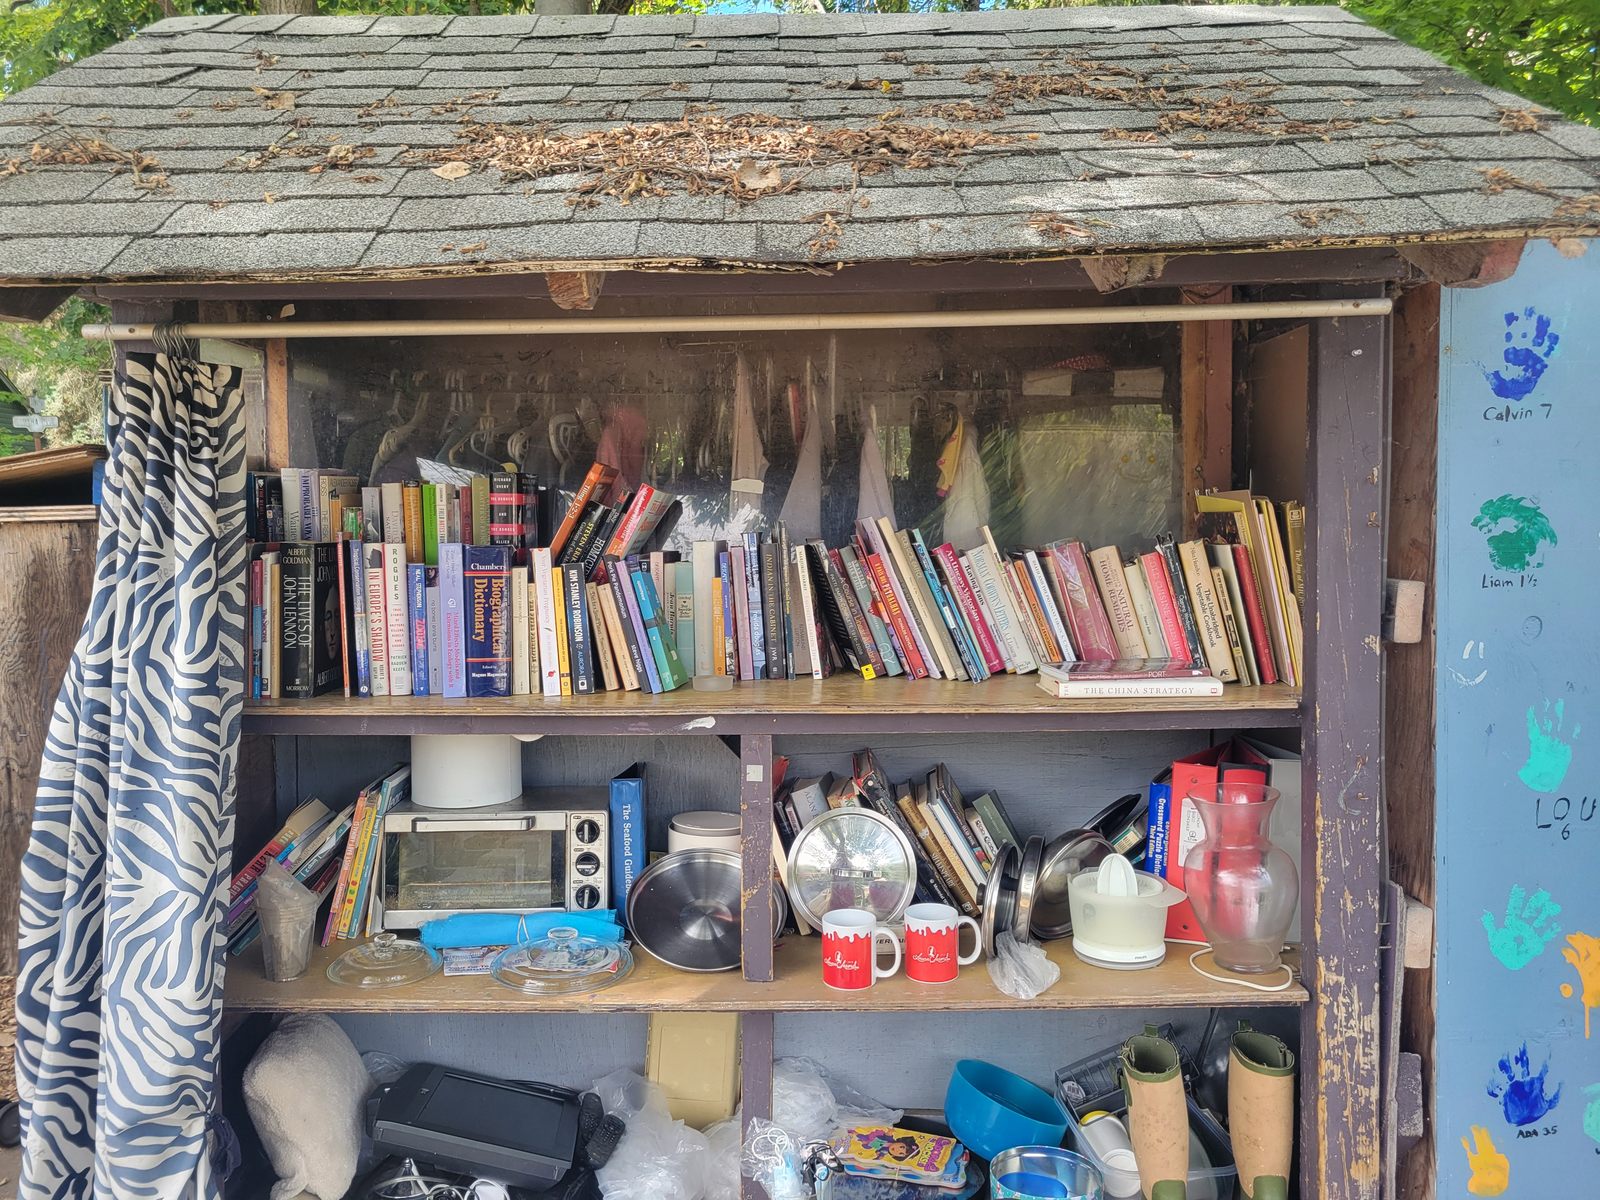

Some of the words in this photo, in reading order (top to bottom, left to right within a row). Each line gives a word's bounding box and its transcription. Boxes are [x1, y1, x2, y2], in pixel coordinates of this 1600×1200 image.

[1483, 404, 1533, 422] Calvin
[1540, 403, 1552, 419] 7
[583, 522, 594, 543] STEVEN
[282, 556, 312, 564] GOLDMAN
[287, 548, 306, 556] ALBERT
[573, 546, 583, 562] ERIK
[945, 548, 956, 562] An
[369, 571, 379, 580] IN
[470, 562, 506, 571] Chambers
[607, 561, 615, 573] Pork
[610, 573, 618, 582] Pie
[766, 554, 774, 582] INDIAN
[950, 562, 967, 589] Uneasy
[963, 565, 978, 589] Raving
[284, 575, 296, 603] JOHN
[298, 576, 311, 595] THE
[839, 576, 847, 584] A
[1482, 574, 1513, 589] Liam
[369, 584, 382, 624] EUROPE'S
[572, 582, 580, 610] STANLEY
[614, 583, 627, 618] Pandemonium
[828, 573, 838, 587] PATTI
[834, 587, 844, 603] SMITH
[840, 603, 854, 628] COMPLETE
[842, 584, 855, 607] Course
[962, 588, 981, 622] Victorian
[1100, 560, 1113, 587] HOME
[1108, 589, 1126, 633] REMEDIES
[1155, 581, 1171, 617] CUISINE
[1203, 589, 1213, 602] The
[298, 601, 311, 631] LIVES
[472, 579, 488, 642] Dictionary
[489, 579, 505, 654] Biographical
[850, 607, 859, 615] in
[1117, 589, 1134, 630] NATURAL
[1194, 583, 1208, 614] Vegetable
[1203, 615, 1216, 647] Cookbook
[1206, 602, 1222, 639] Unabridged
[284, 607, 296, 648] LENNON
[575, 610, 584, 643] ROBINSON
[769, 609, 777, 641] CABINET
[854, 615, 867, 635] Linear
[1182, 612, 1193, 631] Windows
[299, 634, 311, 648] OF
[371, 628, 383, 662] SHADOW
[630, 644, 639, 659] steve
[862, 635, 878, 662] Algebra
[633, 658, 643, 673] higgs
[1142, 686, 1195, 695] STRATEGY
[623, 804, 631, 820] The
[1157, 798, 1165, 831] Crossword
[1535, 796, 1597, 829] LOU
[624, 823, 632, 856] Seafood
[1561, 823, 1570, 840] 6
[930, 852, 955, 889] SHAKESPEARE
[1154, 854, 1162, 876] Diction
[1516, 1129, 1538, 1139] ADA
